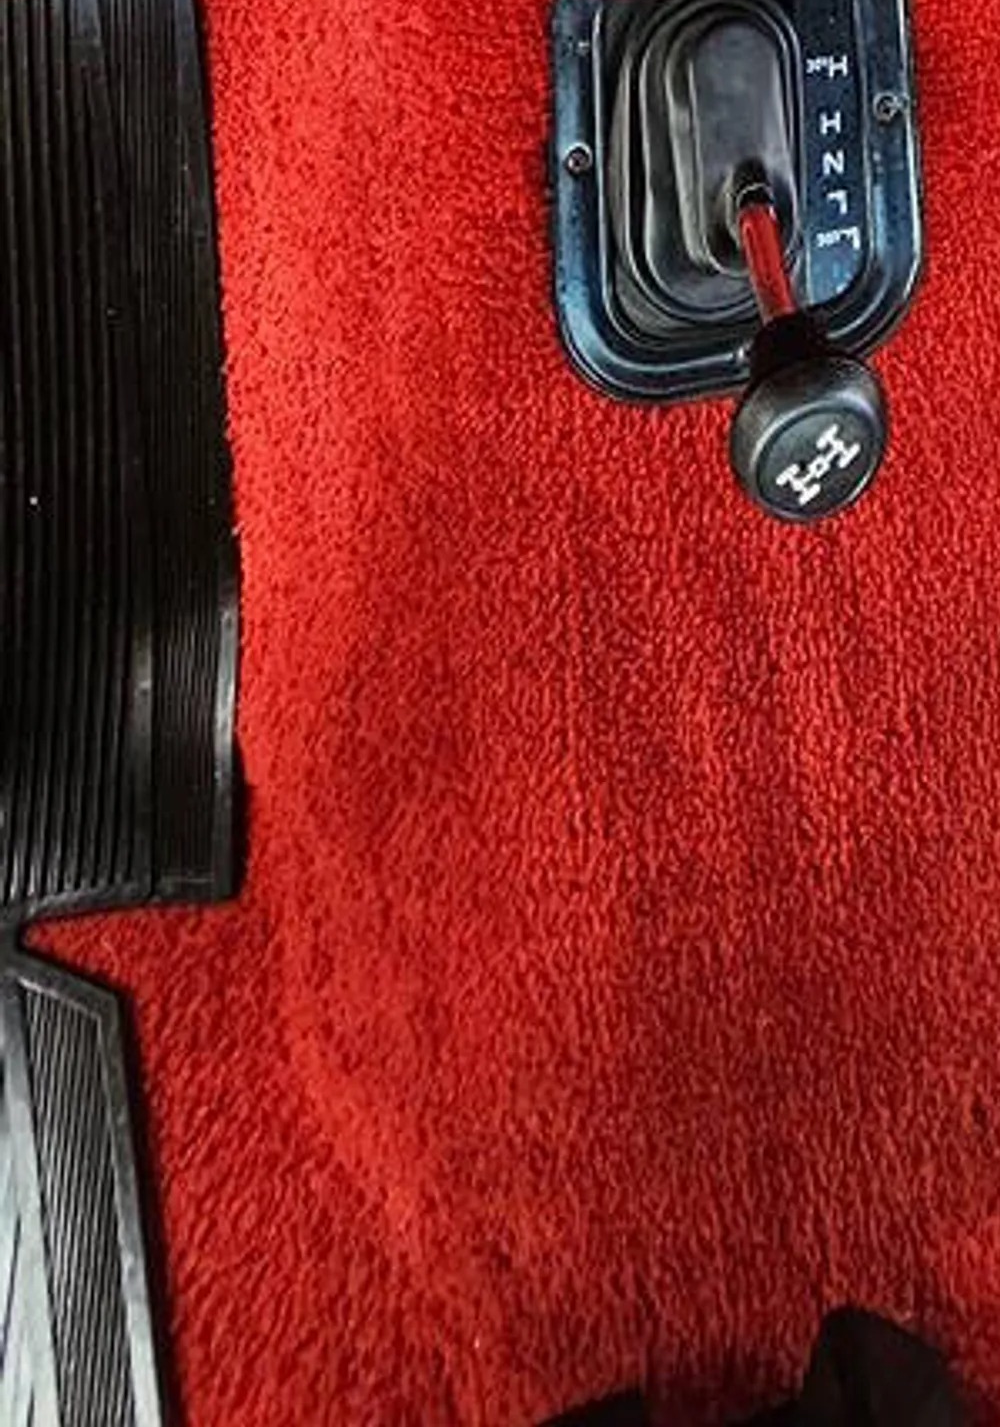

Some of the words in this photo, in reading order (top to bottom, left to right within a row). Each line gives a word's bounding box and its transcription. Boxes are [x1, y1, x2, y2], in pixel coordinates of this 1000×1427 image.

[820, 109, 842, 135] H
[823, 150, 845, 175] N
[827, 188, 849, 215] L
